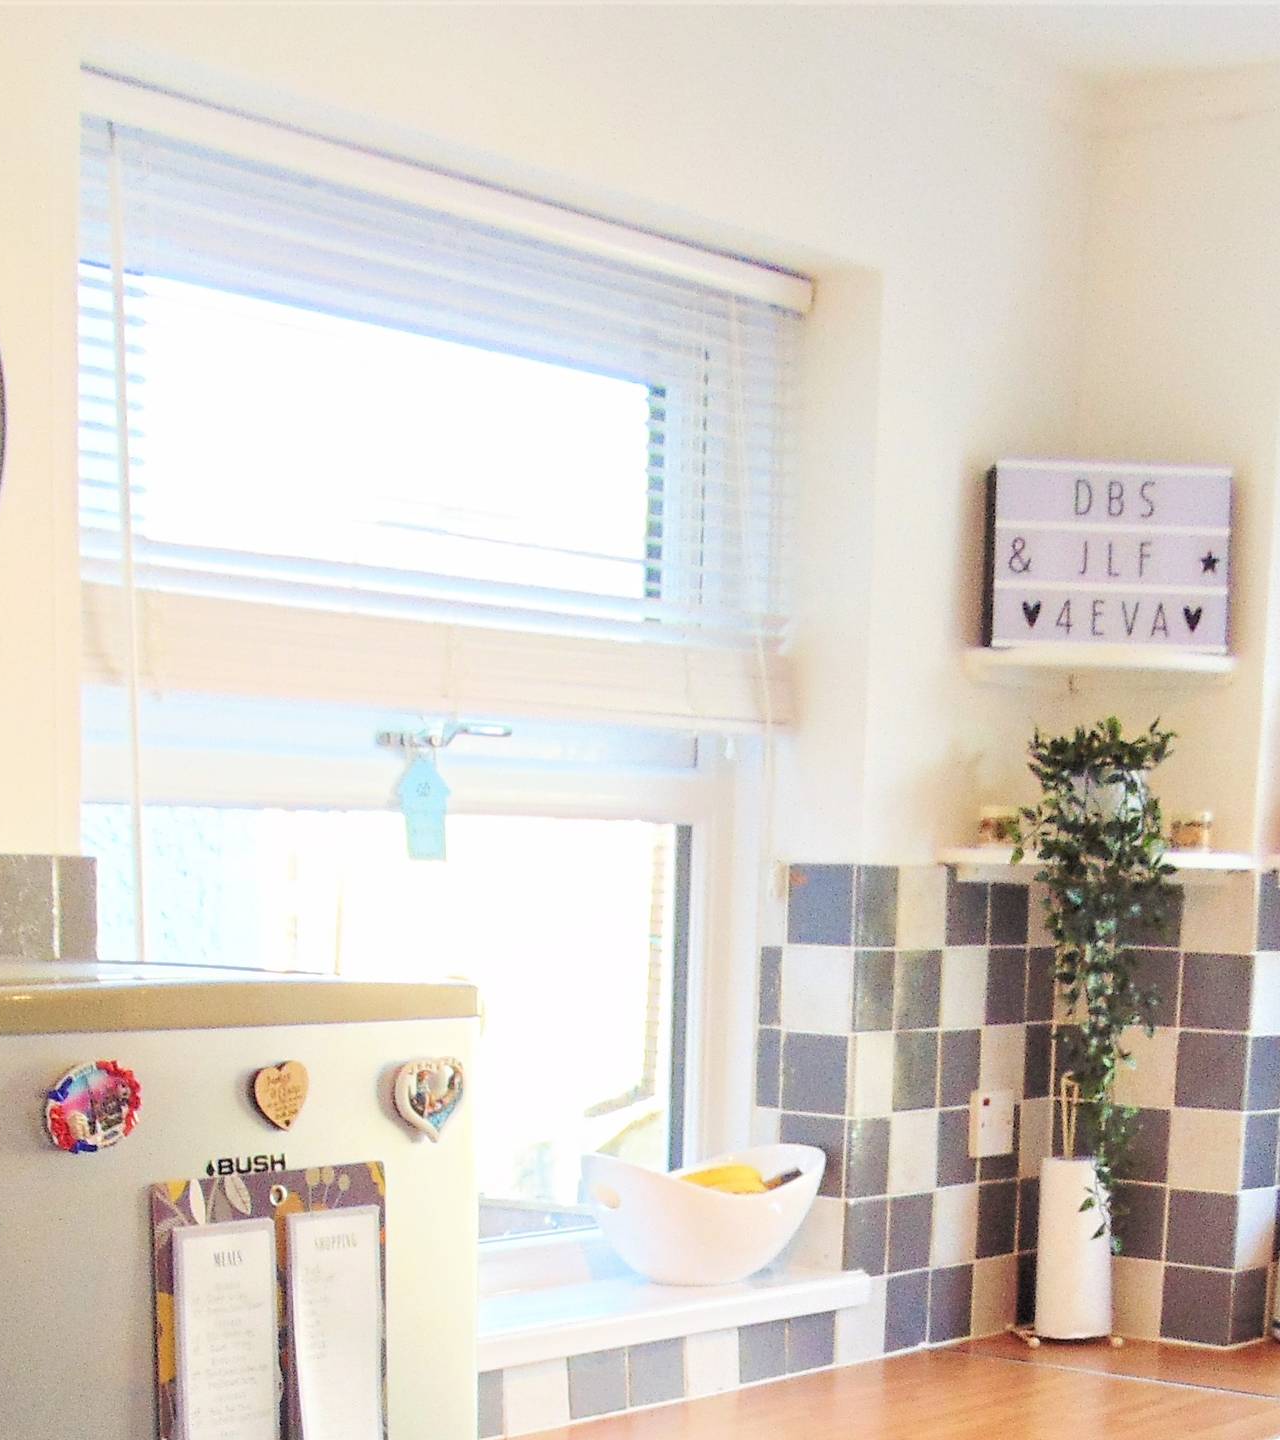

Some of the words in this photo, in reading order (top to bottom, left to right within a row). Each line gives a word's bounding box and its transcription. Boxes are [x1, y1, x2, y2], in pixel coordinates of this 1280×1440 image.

[1073, 478, 1157, 519] DBS
[1007, 537, 1033, 573] &
[1079, 540, 1153, 578] JLF
[1055, 599, 1169, 638] 4EVA
[218, 1154, 287, 1176] BUSH
[213, 1250, 244, 1268] MEALS
